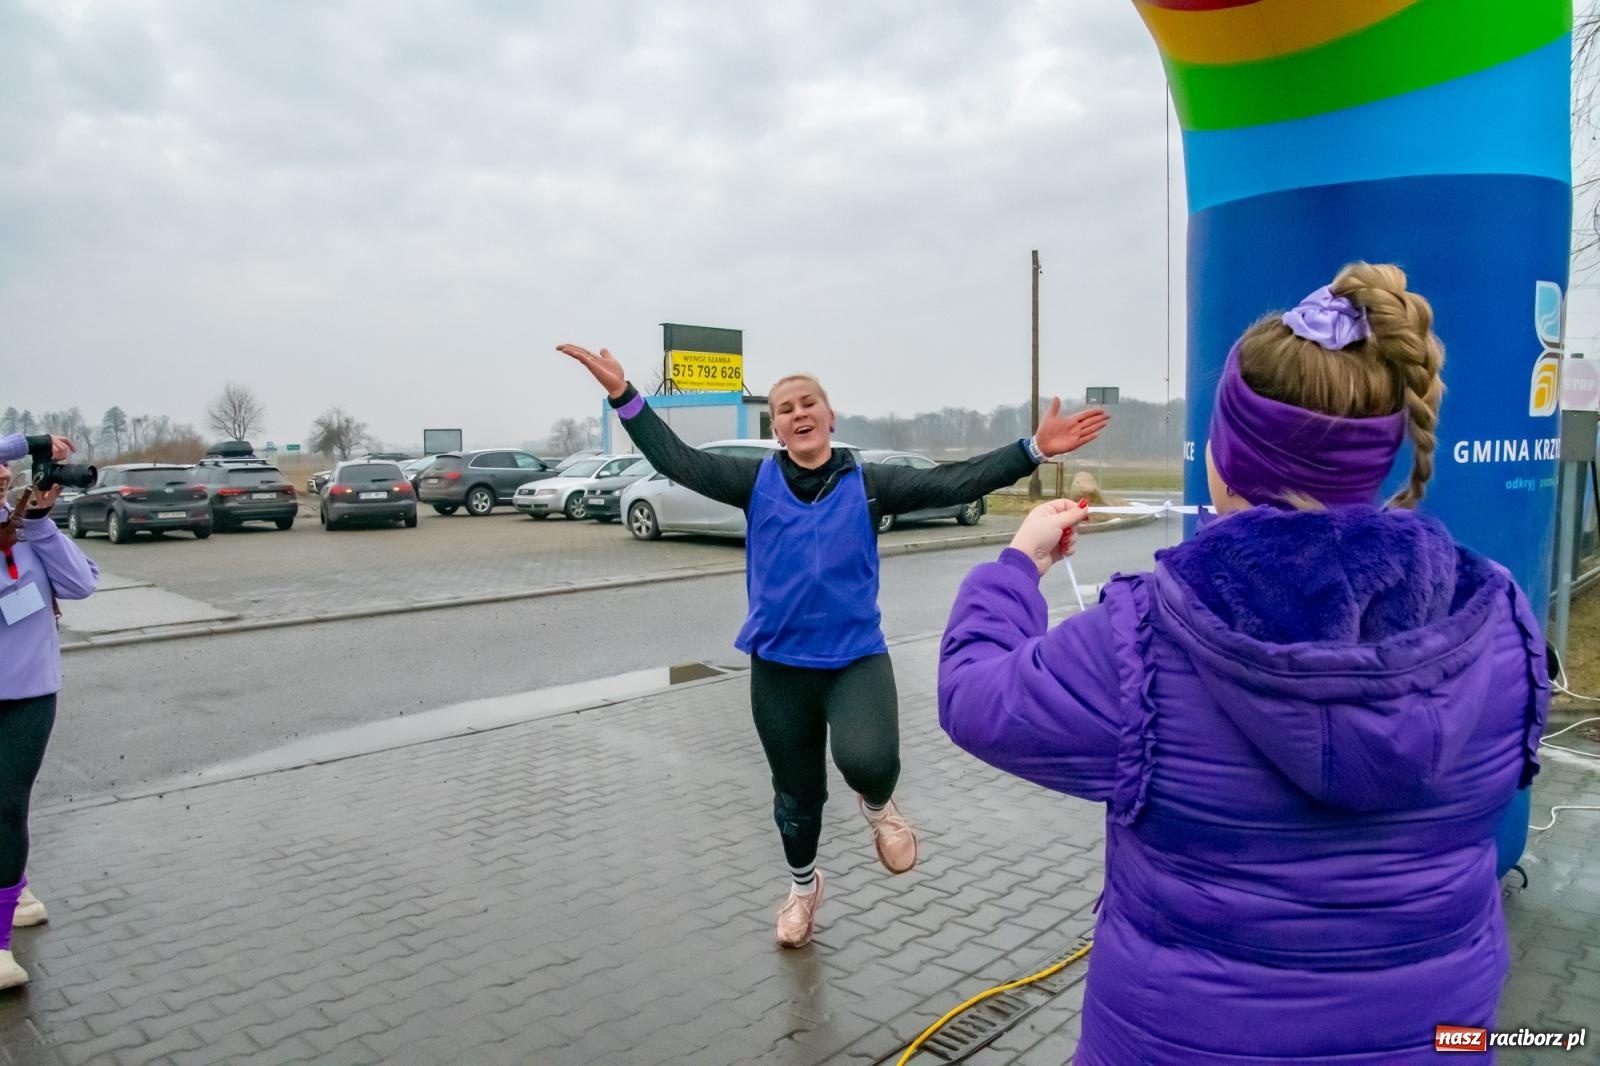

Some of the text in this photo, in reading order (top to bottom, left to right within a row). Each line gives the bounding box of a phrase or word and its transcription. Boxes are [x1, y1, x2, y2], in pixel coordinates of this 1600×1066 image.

[673, 364, 741, 379] 575 792 626
[1565, 379, 1596, 391] STOP
[1454, 439, 1530, 463] GMINA
[1505, 477, 1535, 491] odkryj
